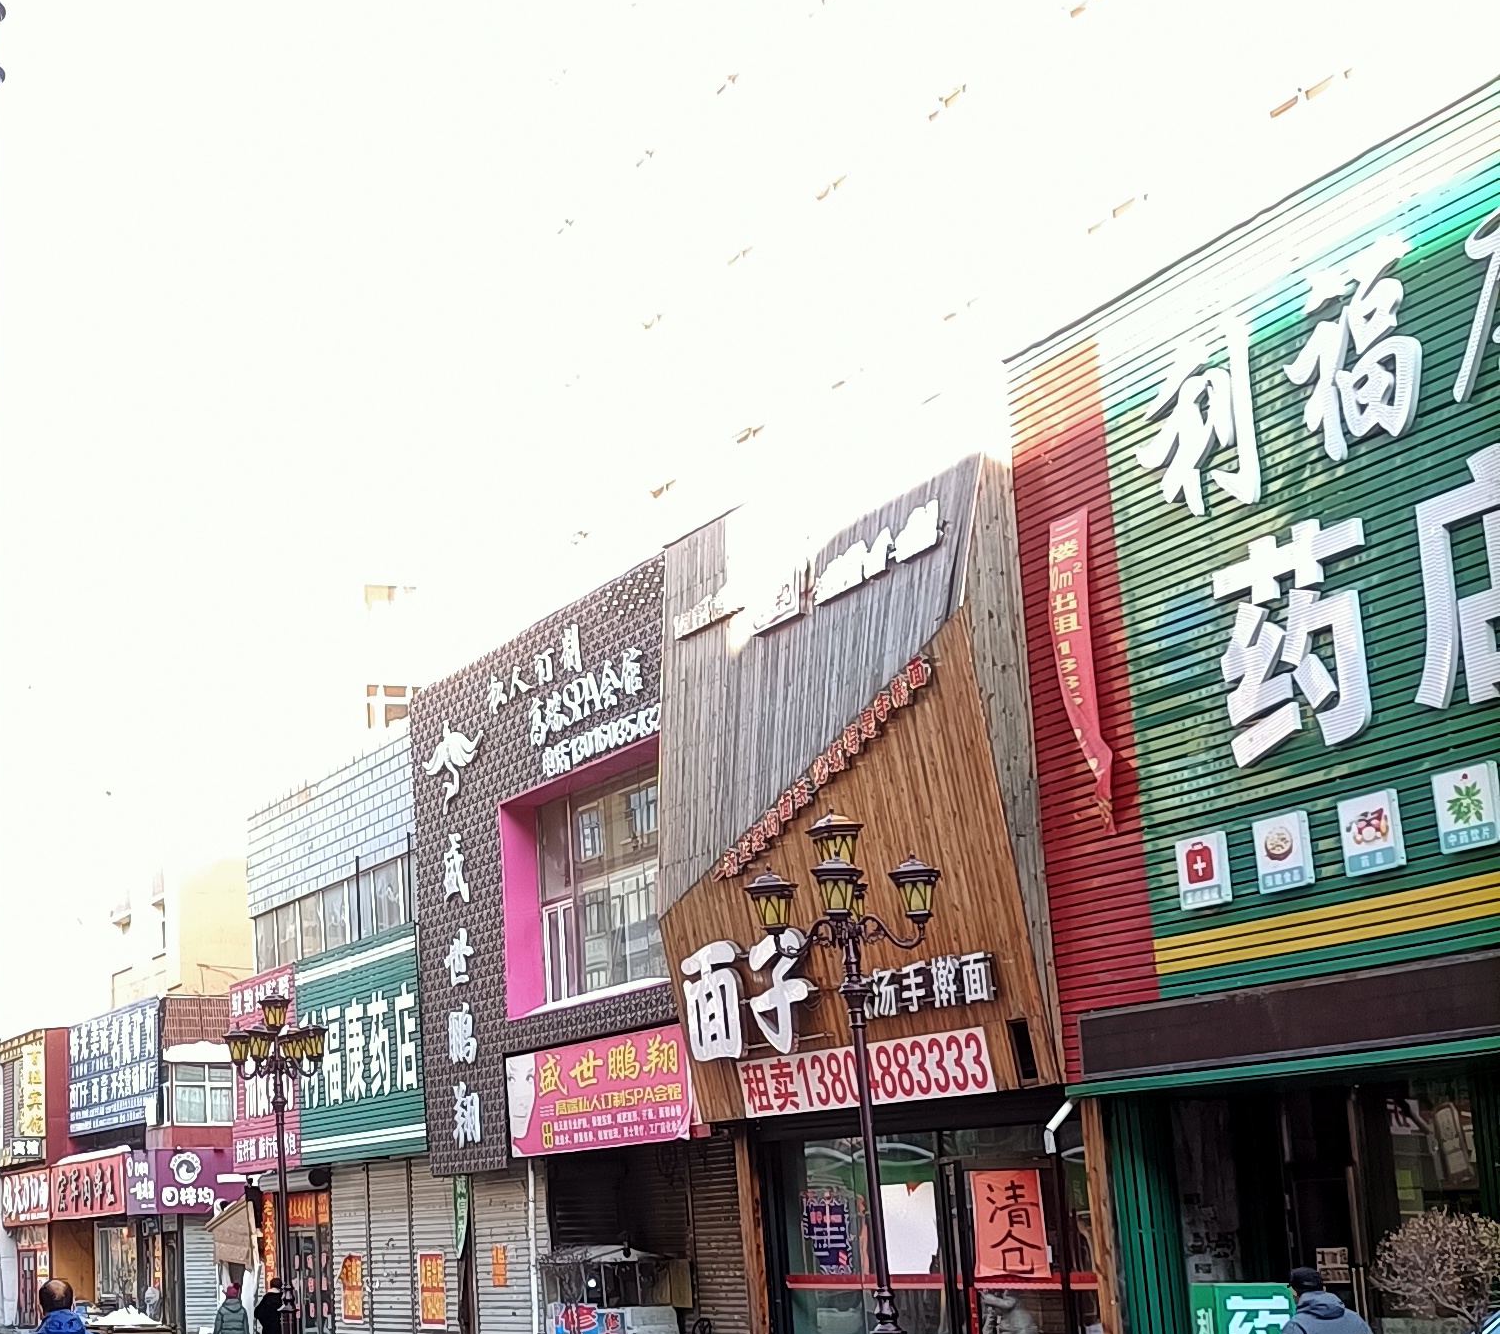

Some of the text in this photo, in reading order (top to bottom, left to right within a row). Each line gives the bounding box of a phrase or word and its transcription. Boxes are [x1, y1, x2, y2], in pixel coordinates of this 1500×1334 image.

[1447, 827, 1492, 845] 中药饮片
[443, 832, 482, 1149] 盛世鹏翔
[680, 927, 809, 1062] 面子
[538, 1033, 679, 1097] 盛世鹏翔
[741, 1031, 989, 1115] 租卖13804883333
[985, 1179, 1042, 1275] 清仓
